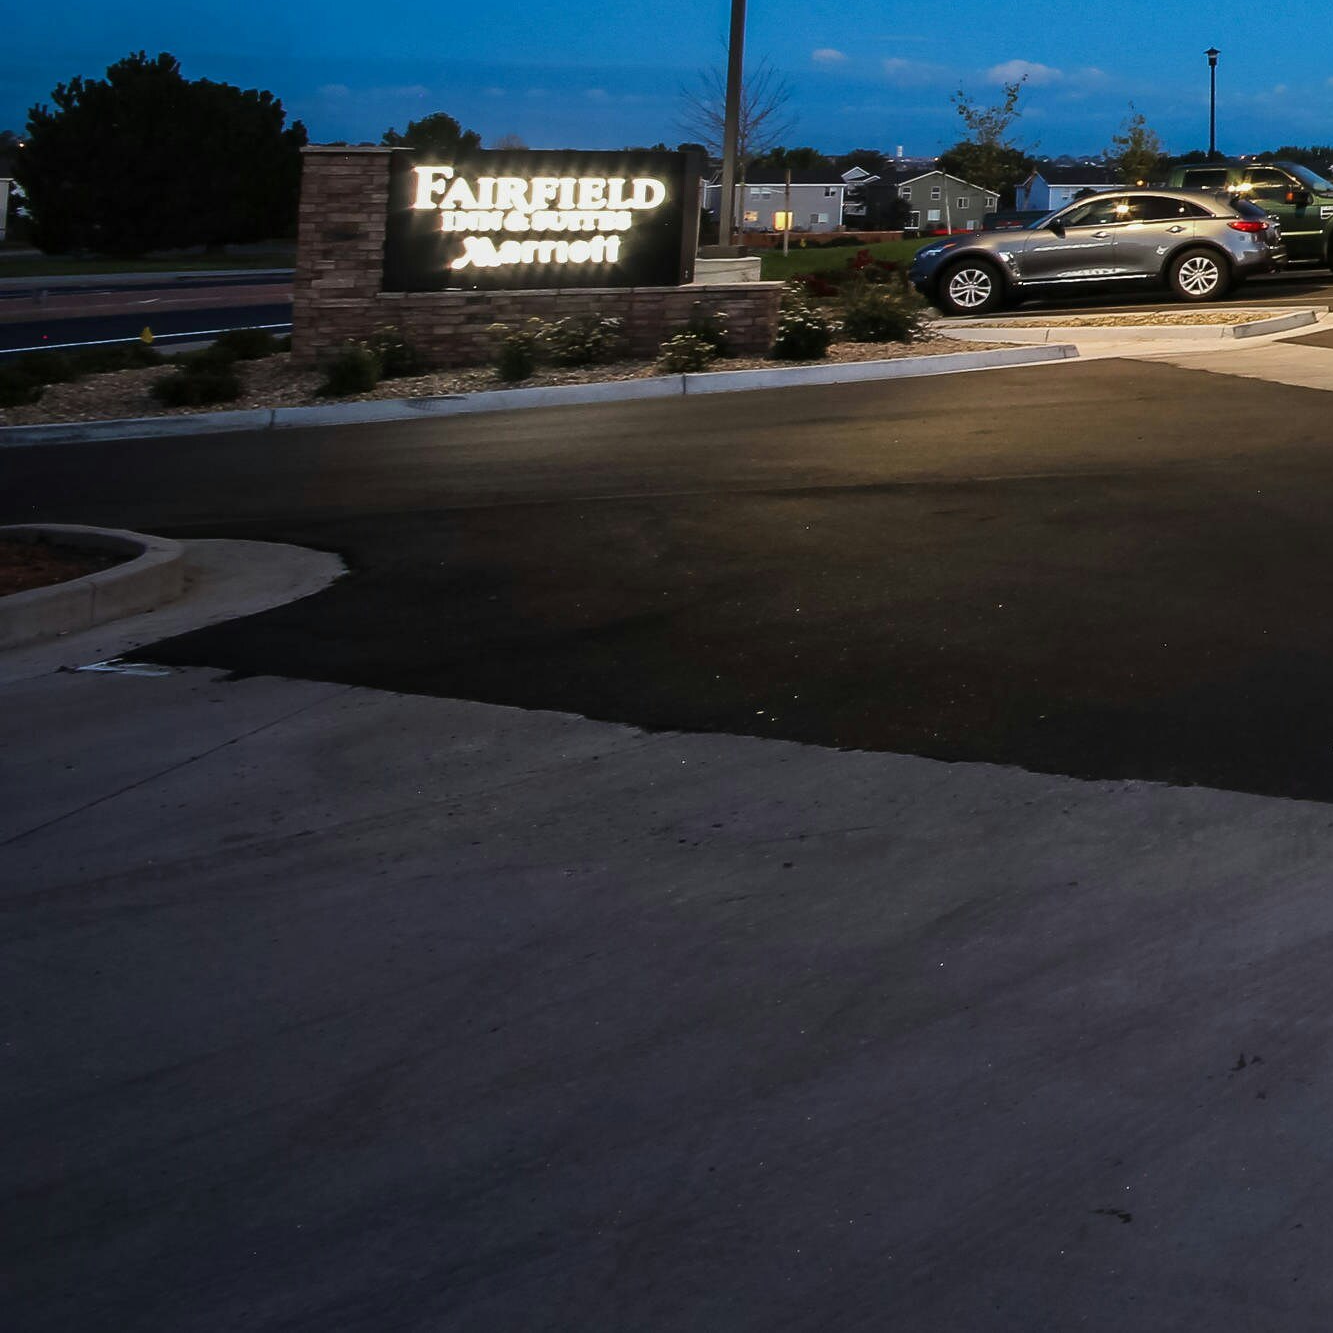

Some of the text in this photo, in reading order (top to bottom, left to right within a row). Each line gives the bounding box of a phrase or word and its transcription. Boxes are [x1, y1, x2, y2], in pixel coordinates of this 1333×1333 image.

[413, 166, 666, 210] FAIRFIELD
[441, 210, 504, 231] INN
[531, 210, 632, 231] SUITES
[451, 235, 622, 269] Marriott
